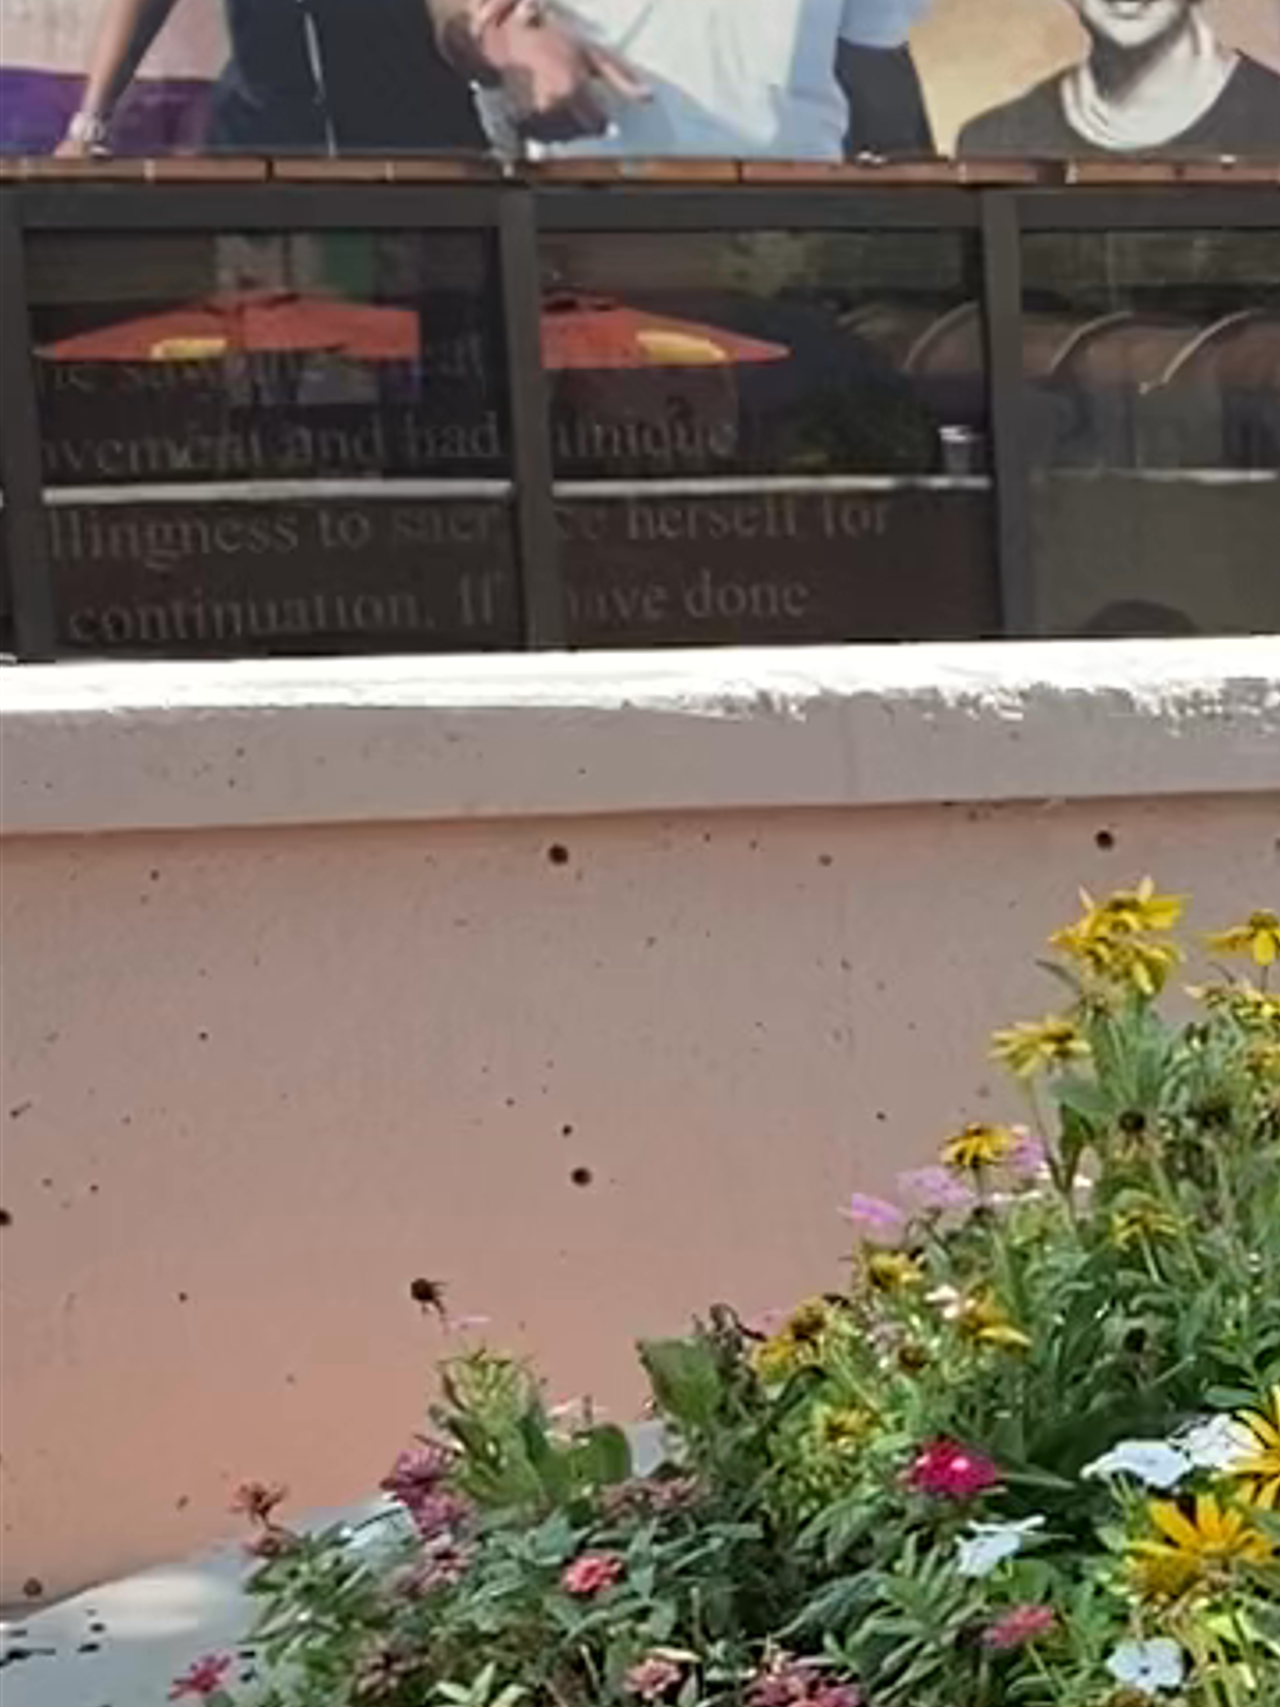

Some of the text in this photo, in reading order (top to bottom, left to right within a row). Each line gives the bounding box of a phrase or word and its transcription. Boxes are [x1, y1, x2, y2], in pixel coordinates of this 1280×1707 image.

[314, 507, 373, 555] to
[67, 585, 439, 645] continuation.
[684, 566, 812, 620] done
